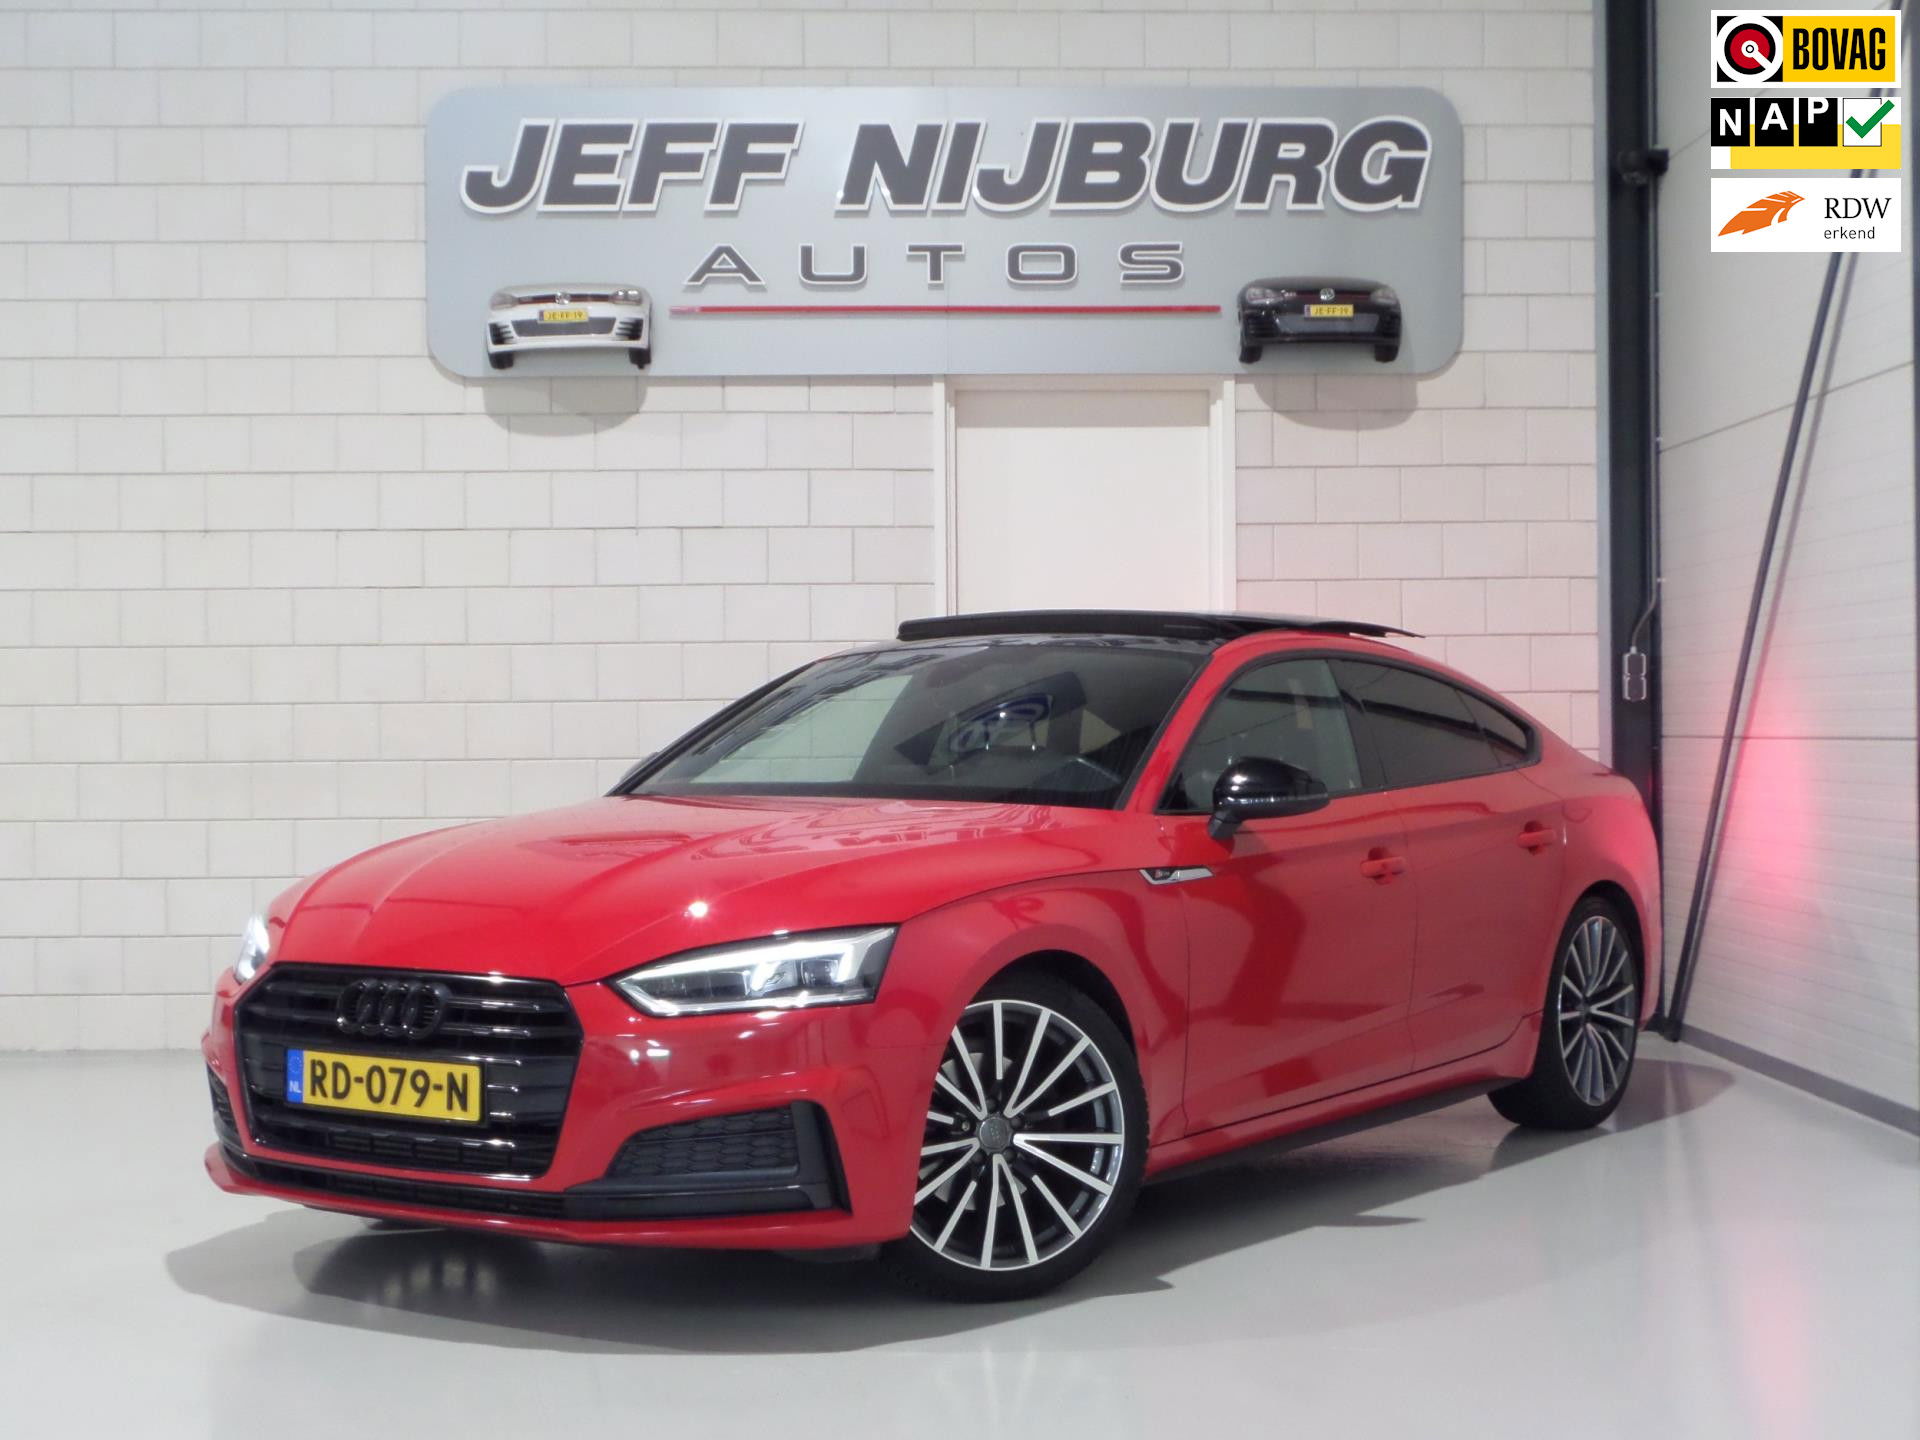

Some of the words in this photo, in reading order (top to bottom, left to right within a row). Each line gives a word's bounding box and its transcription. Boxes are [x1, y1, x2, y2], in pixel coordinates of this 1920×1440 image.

[461, 119, 804, 213] JEFF
[835, 116, 1432, 213] NIJBURG
[684, 242, 1185, 287] AUTOS
[289, 1080, 301, 1093] NL
[309, 1058, 469, 1113] RD-079-N
